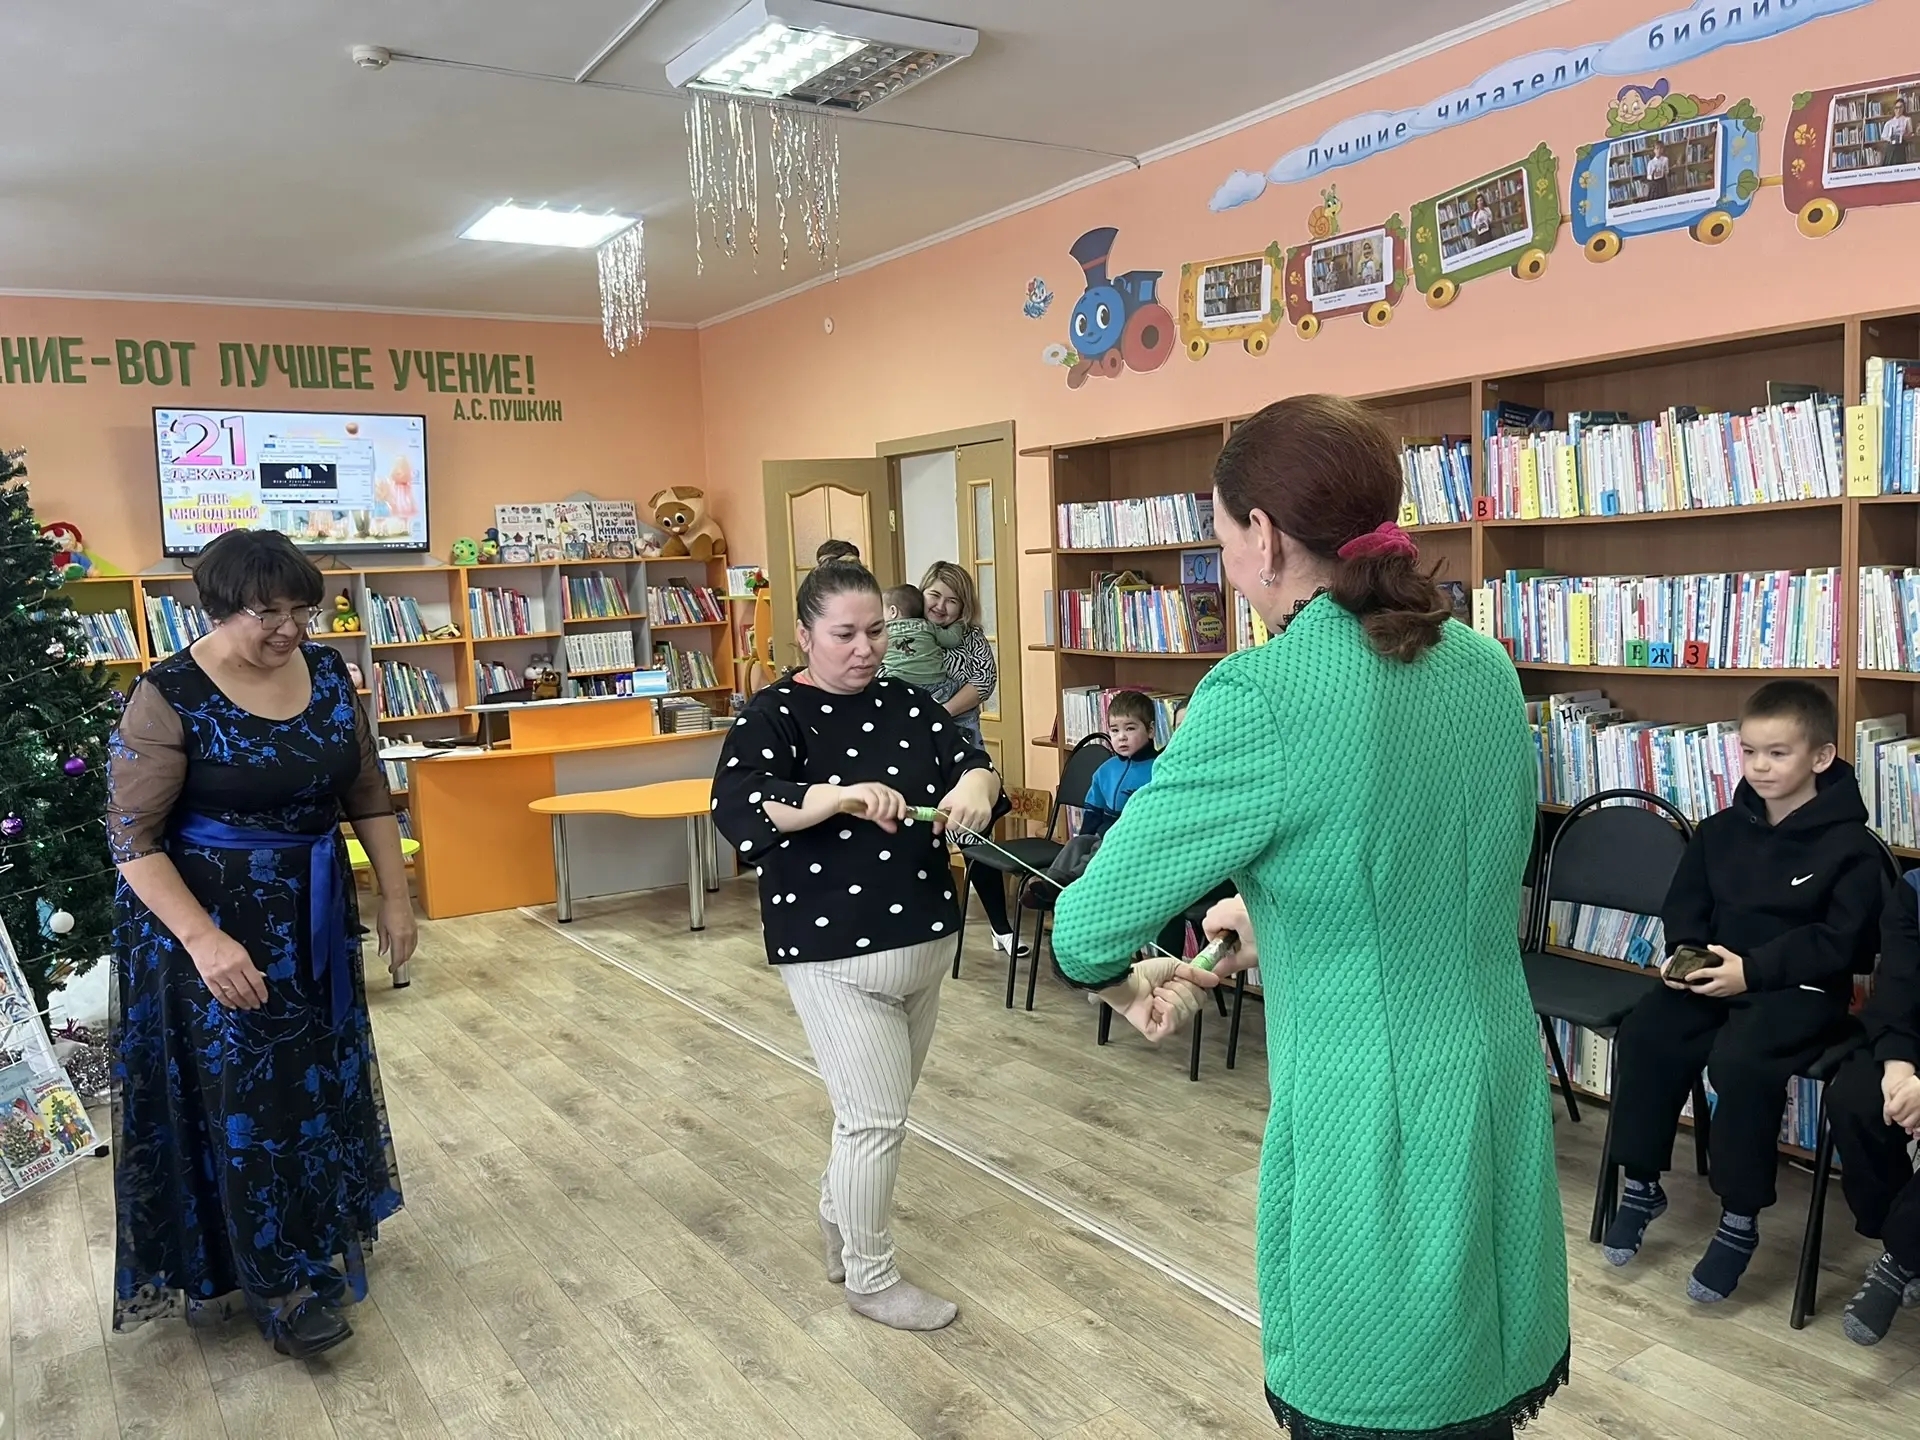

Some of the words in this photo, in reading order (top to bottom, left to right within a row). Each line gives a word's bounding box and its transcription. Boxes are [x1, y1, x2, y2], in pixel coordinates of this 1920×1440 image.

[1305, 120, 1407, 170] Лучшие
[1437, 56, 1590, 120] читатели
[218, 342, 375, 390] ЛУЧШЕЕ
[388, 349, 536, 395] УЧЕНИЕ!
[170, 413, 246, 466] 21
[198, 493, 230, 505] ДЕНЬ
[1403, 506, 1413, 522] Б
[1477, 501, 1488, 517] В
[1632, 644, 1643, 661] Е
[1651, 648, 1670, 665] Ж
